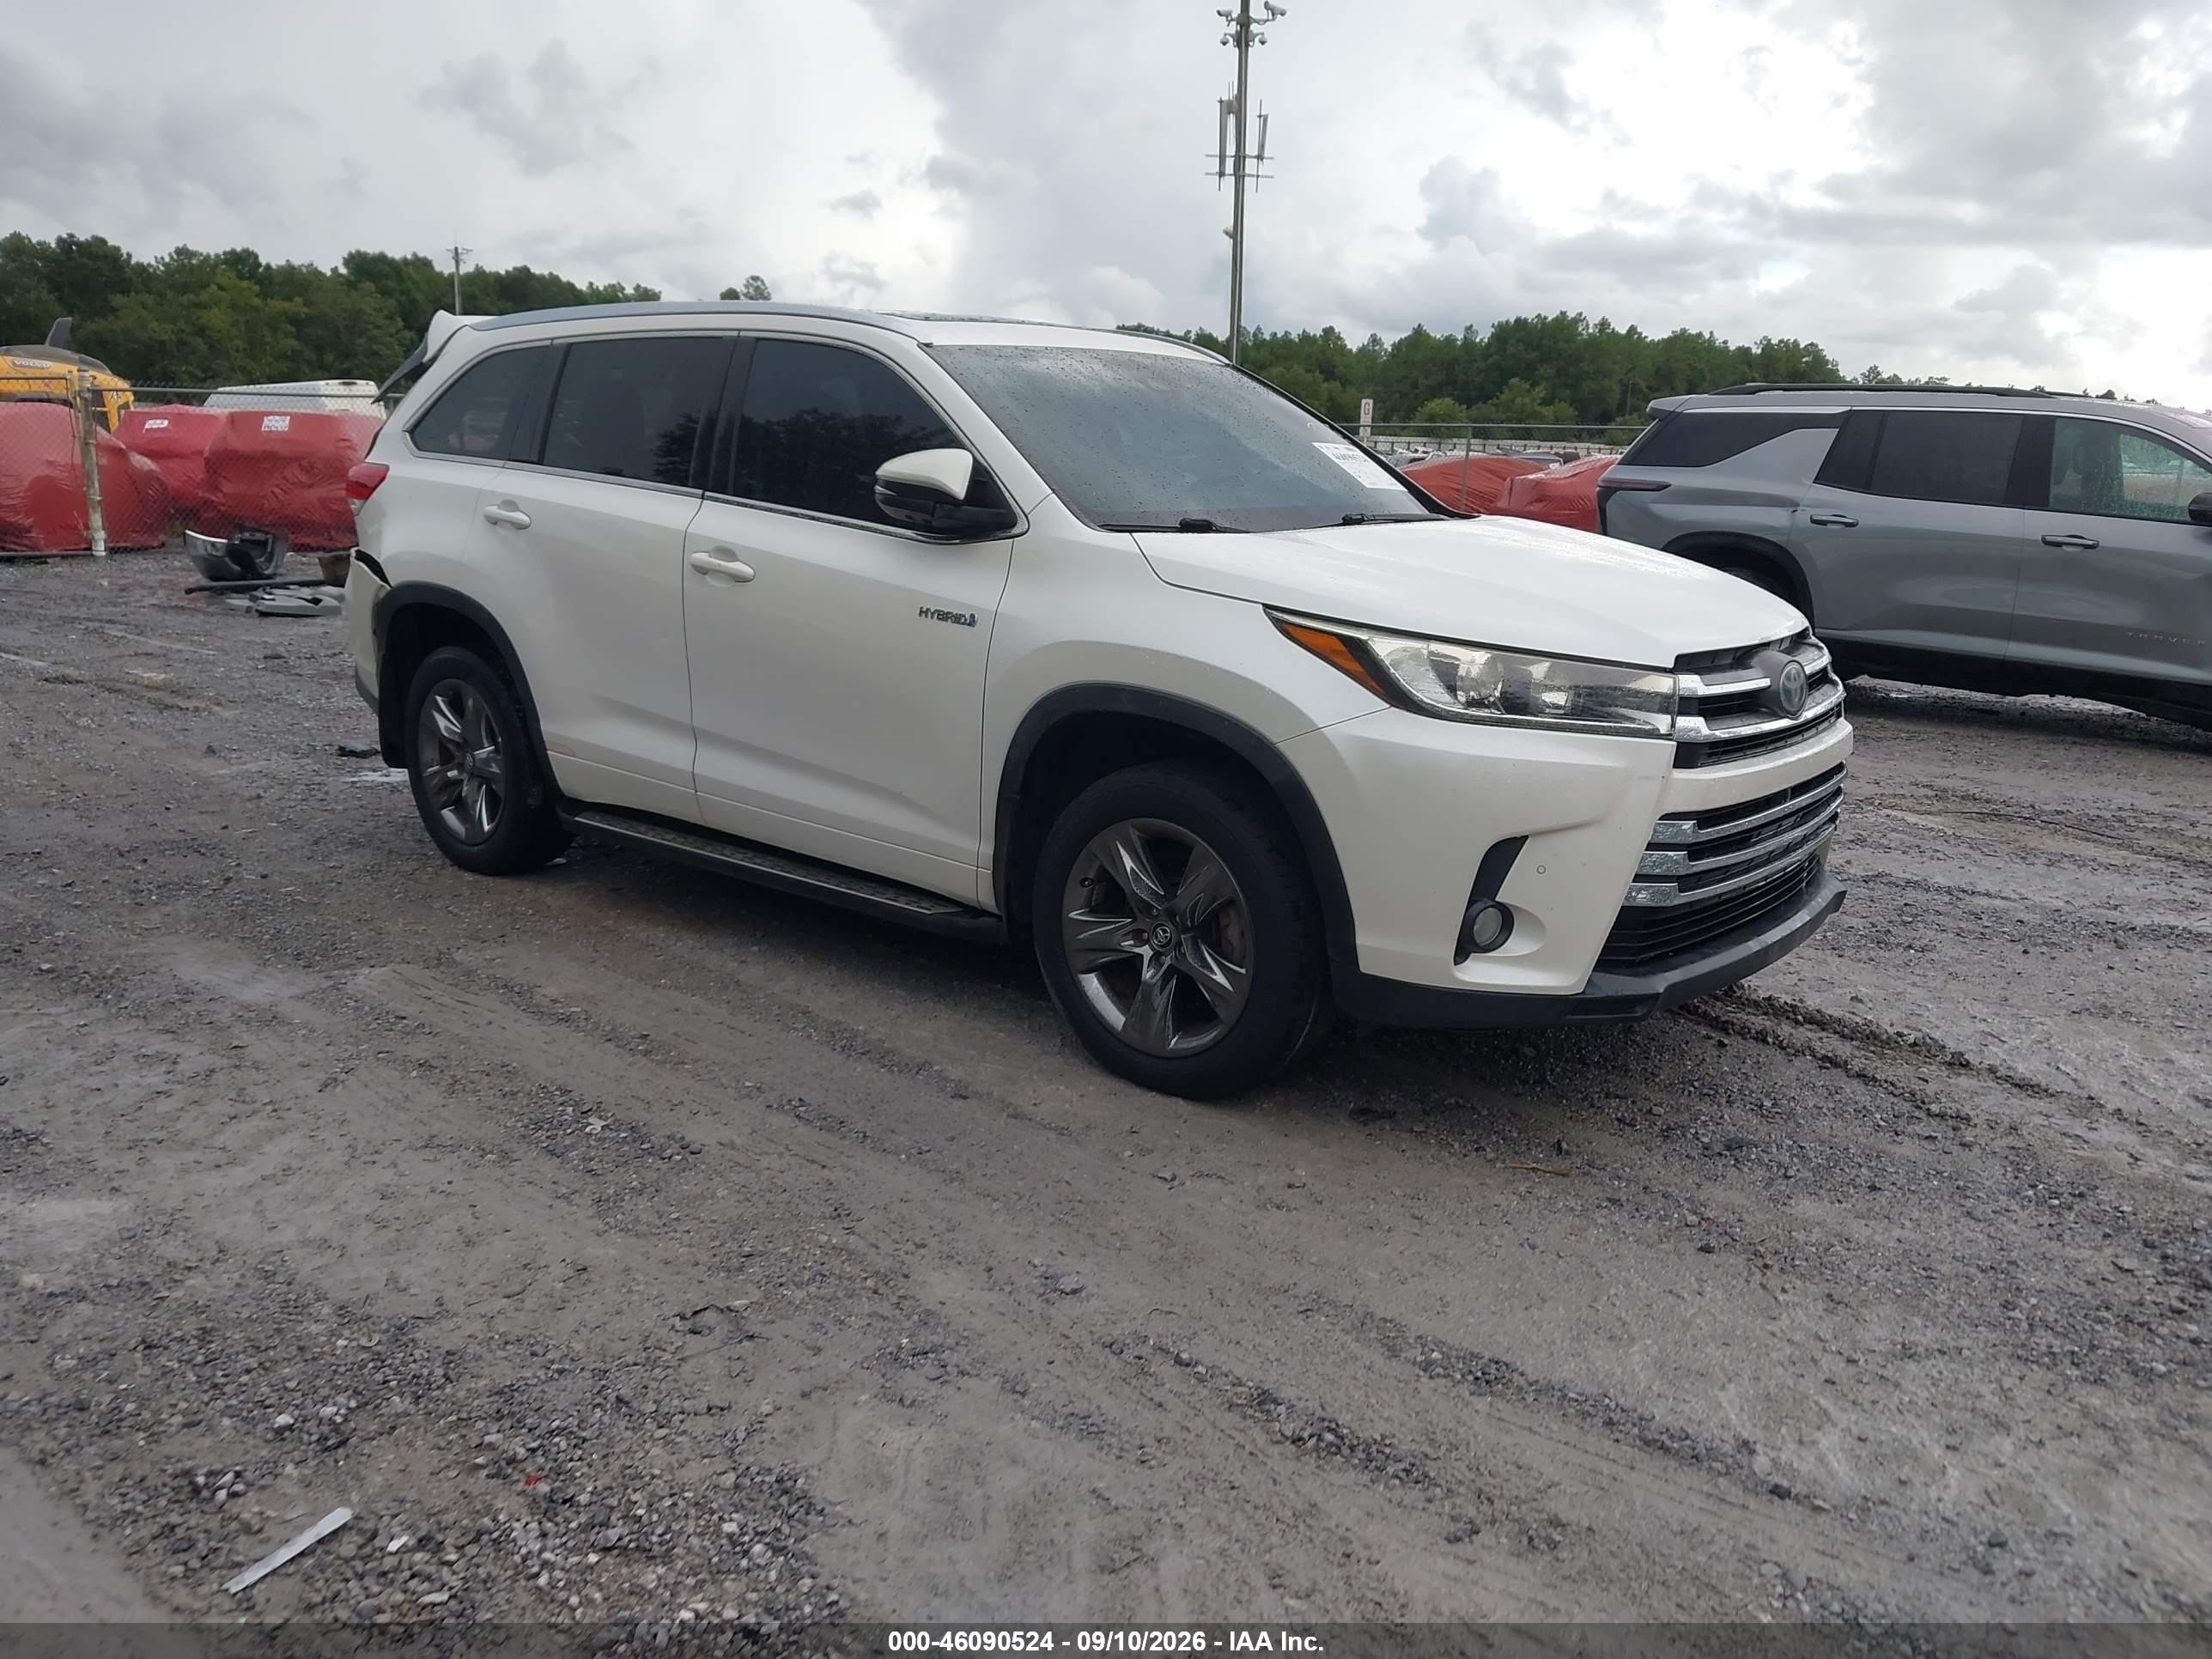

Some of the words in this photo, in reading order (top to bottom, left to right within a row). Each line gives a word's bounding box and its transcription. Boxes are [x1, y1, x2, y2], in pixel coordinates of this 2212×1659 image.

[13, 359, 52, 368] VOLVO
[1363, 401, 1370, 416] G
[918, 606, 968, 626] HYBRID
